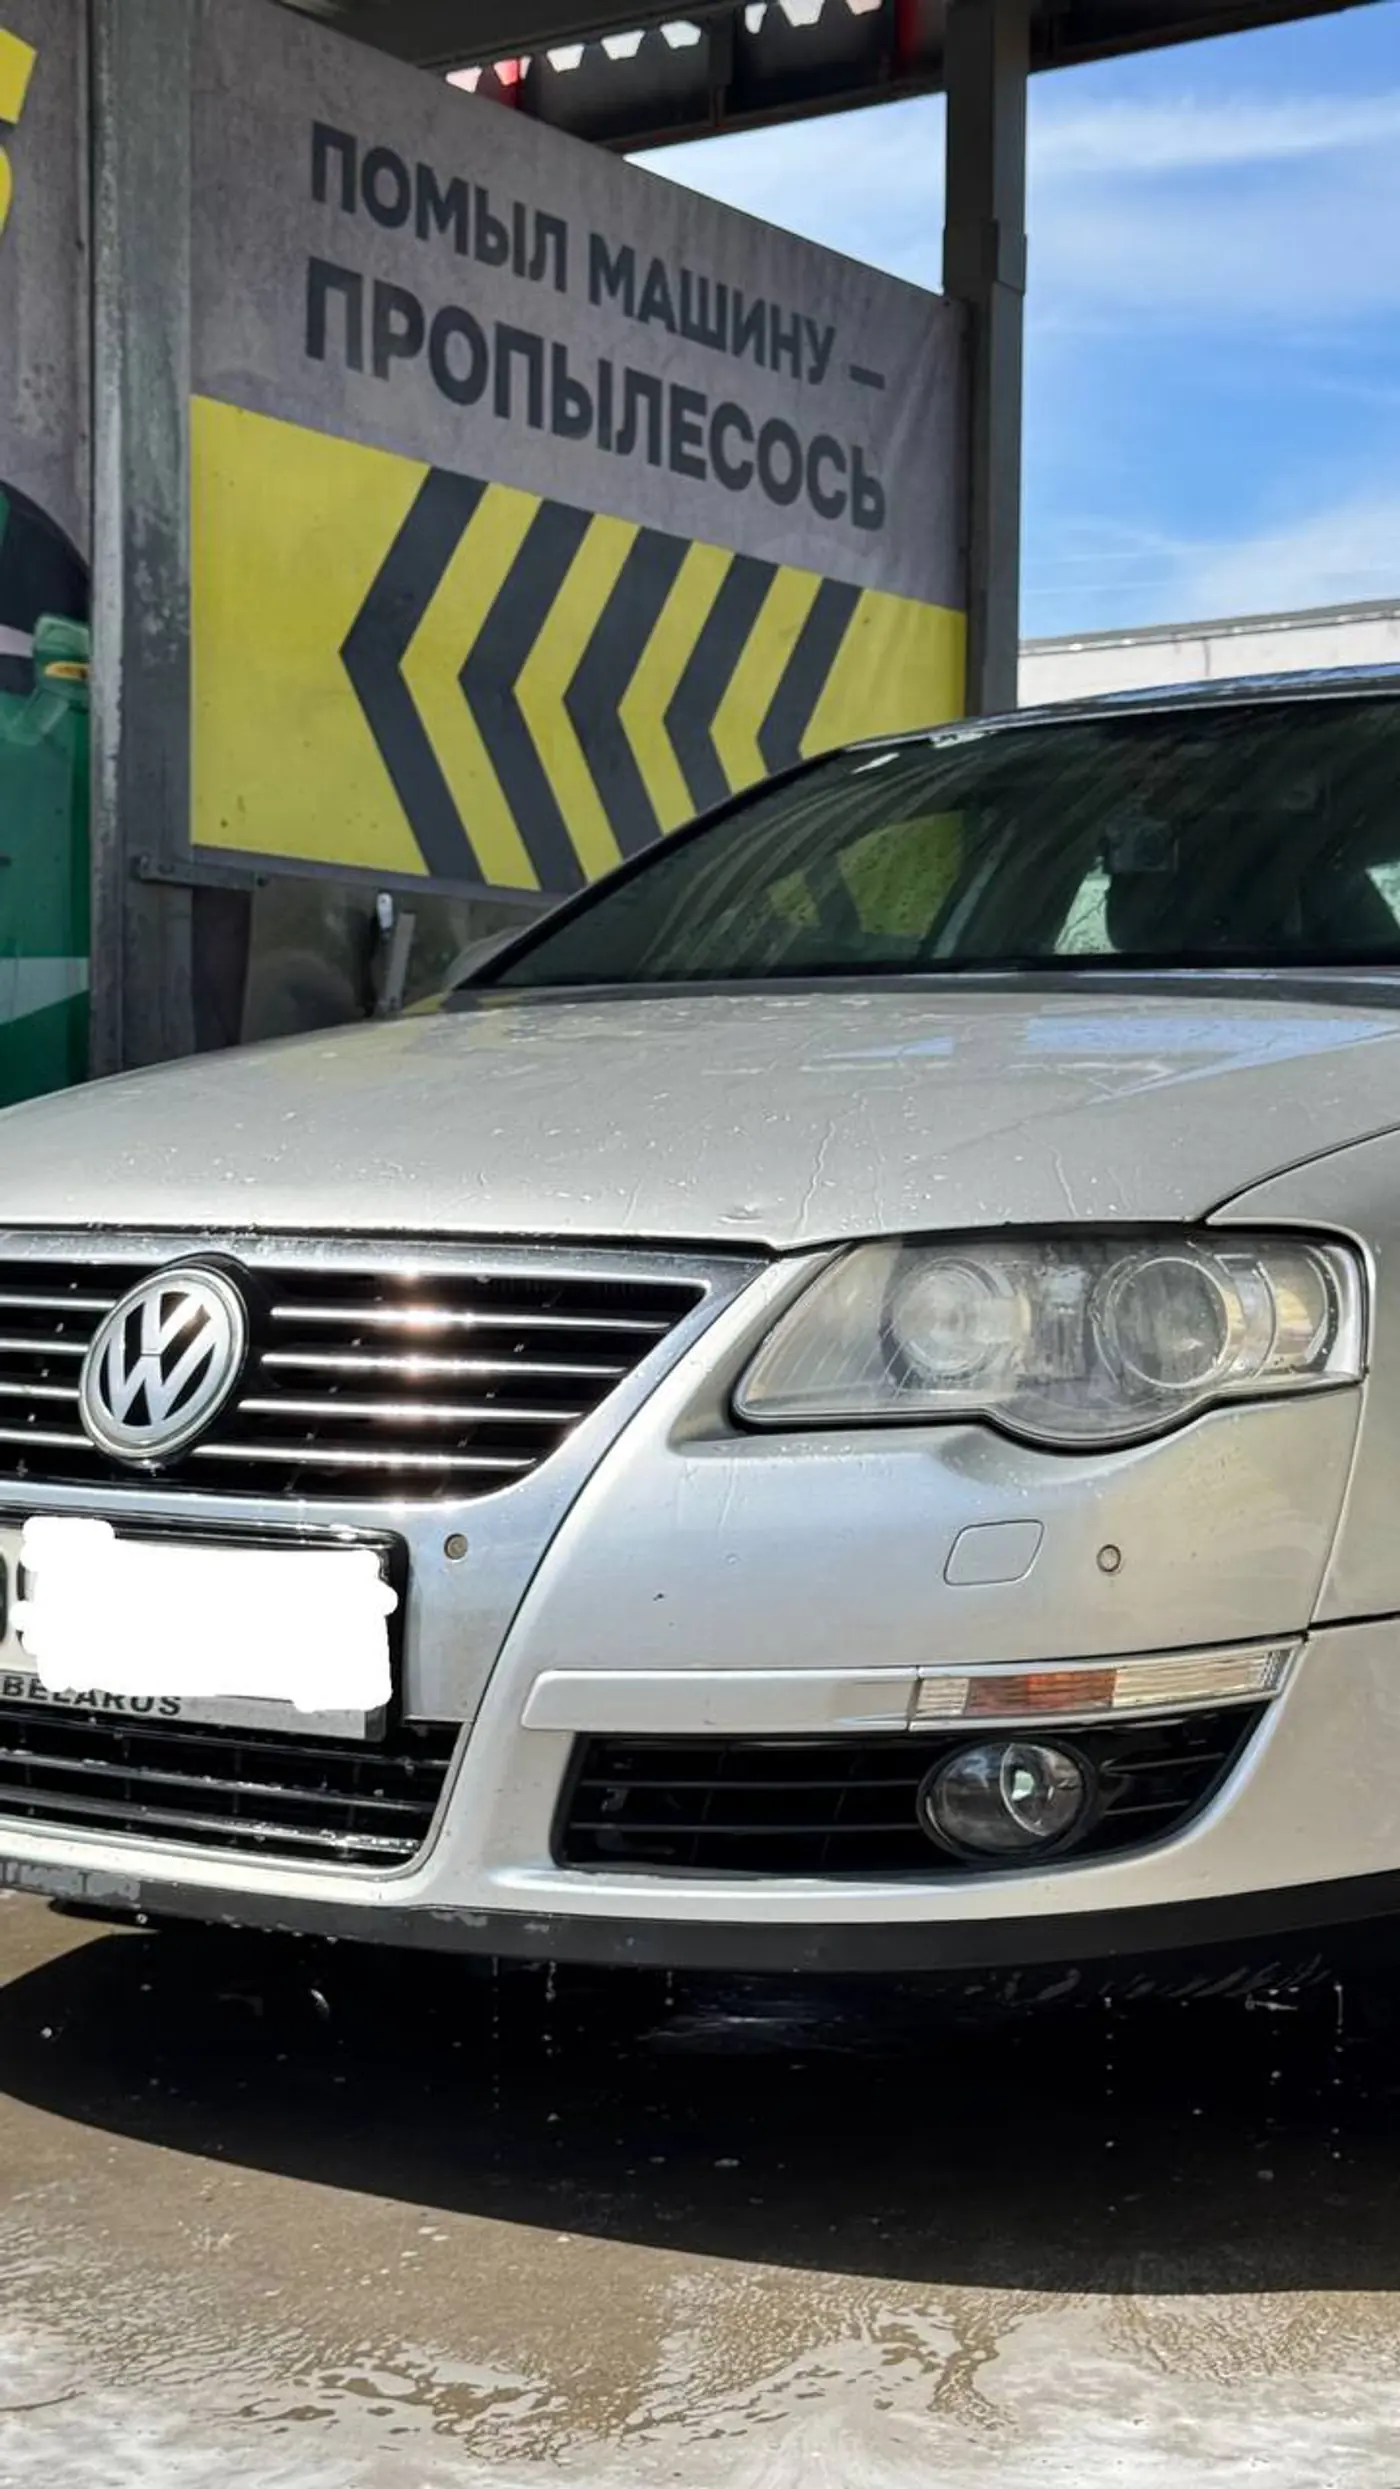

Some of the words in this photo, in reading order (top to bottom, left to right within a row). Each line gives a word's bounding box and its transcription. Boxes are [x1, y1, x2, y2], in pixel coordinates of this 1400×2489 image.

[311, 120, 568, 292] ПОМЫЛ
[588, 231, 836, 385] МАШИНУ
[304, 256, 887, 532] ПРОПЫЛЕСОСЬ
